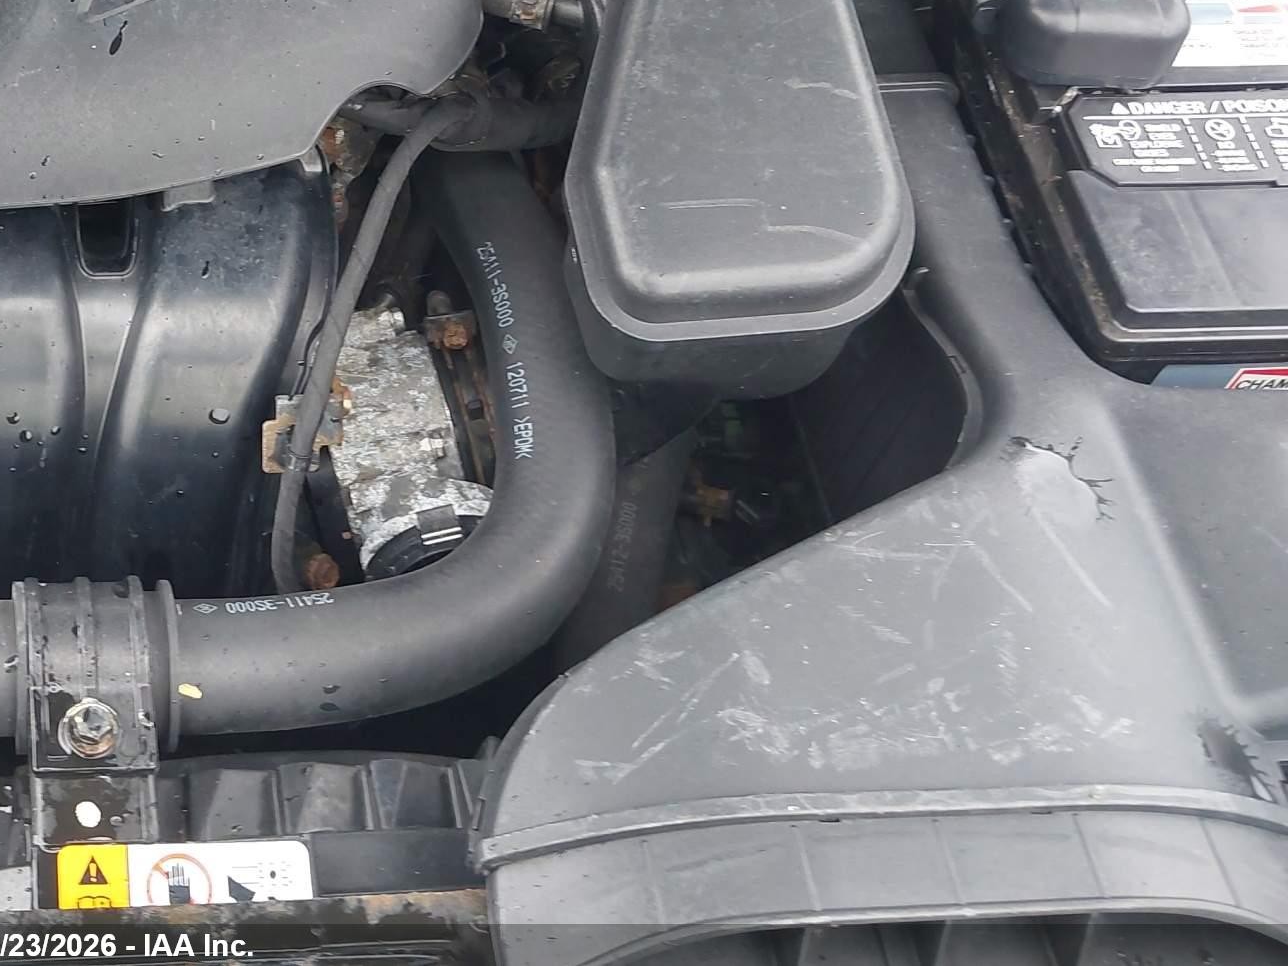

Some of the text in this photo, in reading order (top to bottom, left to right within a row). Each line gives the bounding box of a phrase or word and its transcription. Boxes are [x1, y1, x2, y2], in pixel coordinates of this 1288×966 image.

[1128, 101, 1208, 115] DANGER
[506, 361, 530, 409] 120711
[225, 592, 335, 614] 25411-3S000
